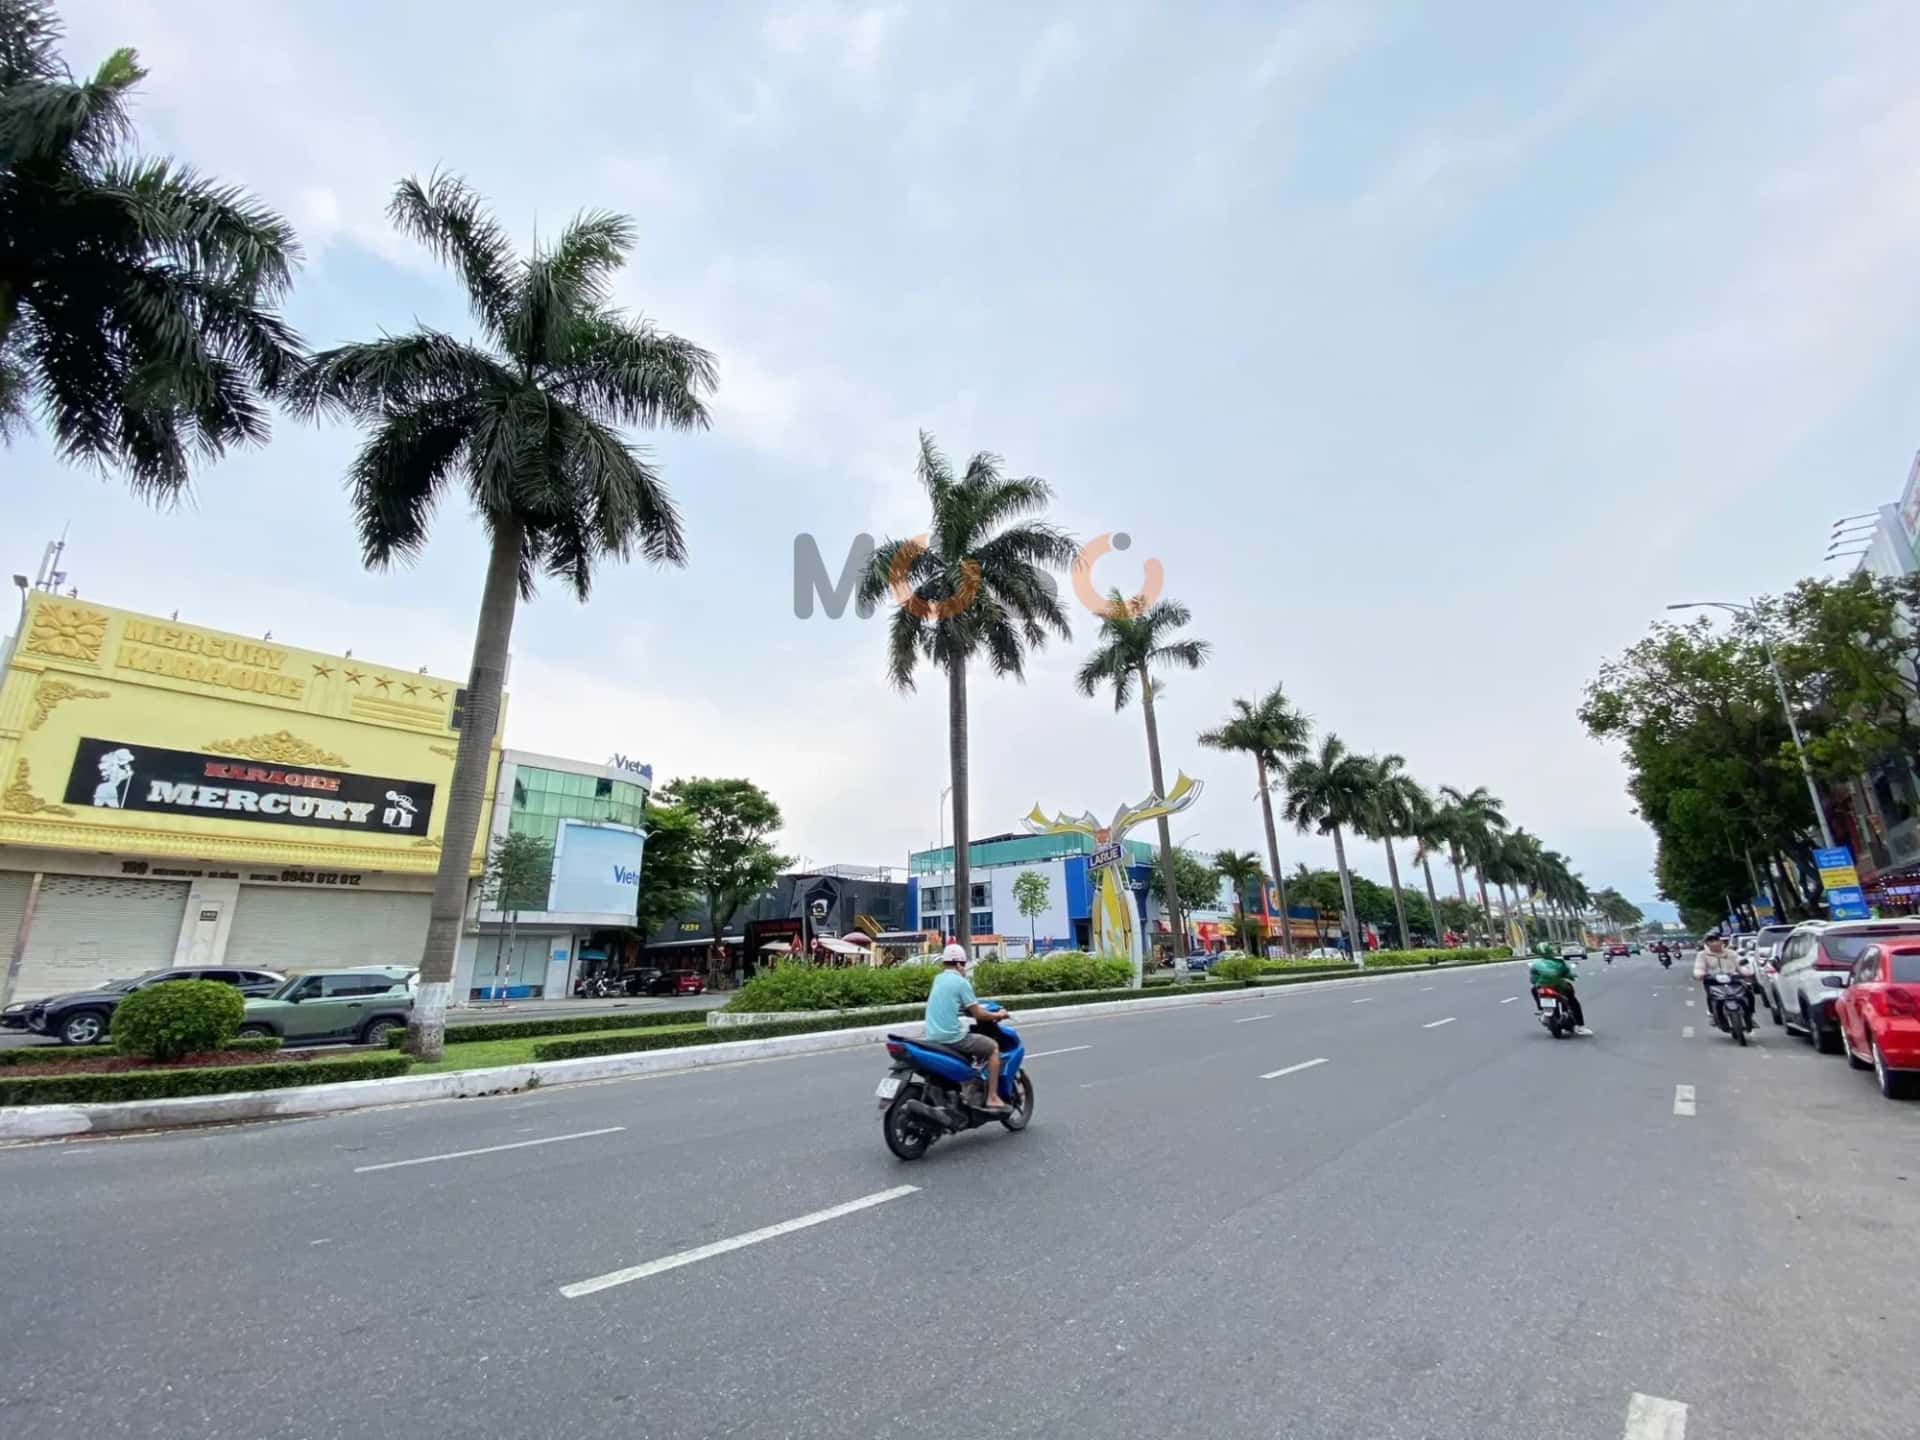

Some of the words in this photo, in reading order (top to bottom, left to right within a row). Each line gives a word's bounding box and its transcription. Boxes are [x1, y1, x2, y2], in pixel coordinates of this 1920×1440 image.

[123, 619, 288, 670] MERCURY
[115, 645, 305, 700] KARAOKE
[204, 762, 341, 792] KARAOKE
[146, 780, 375, 824] MERCURY
[1089, 847, 1119, 868] LARUE
